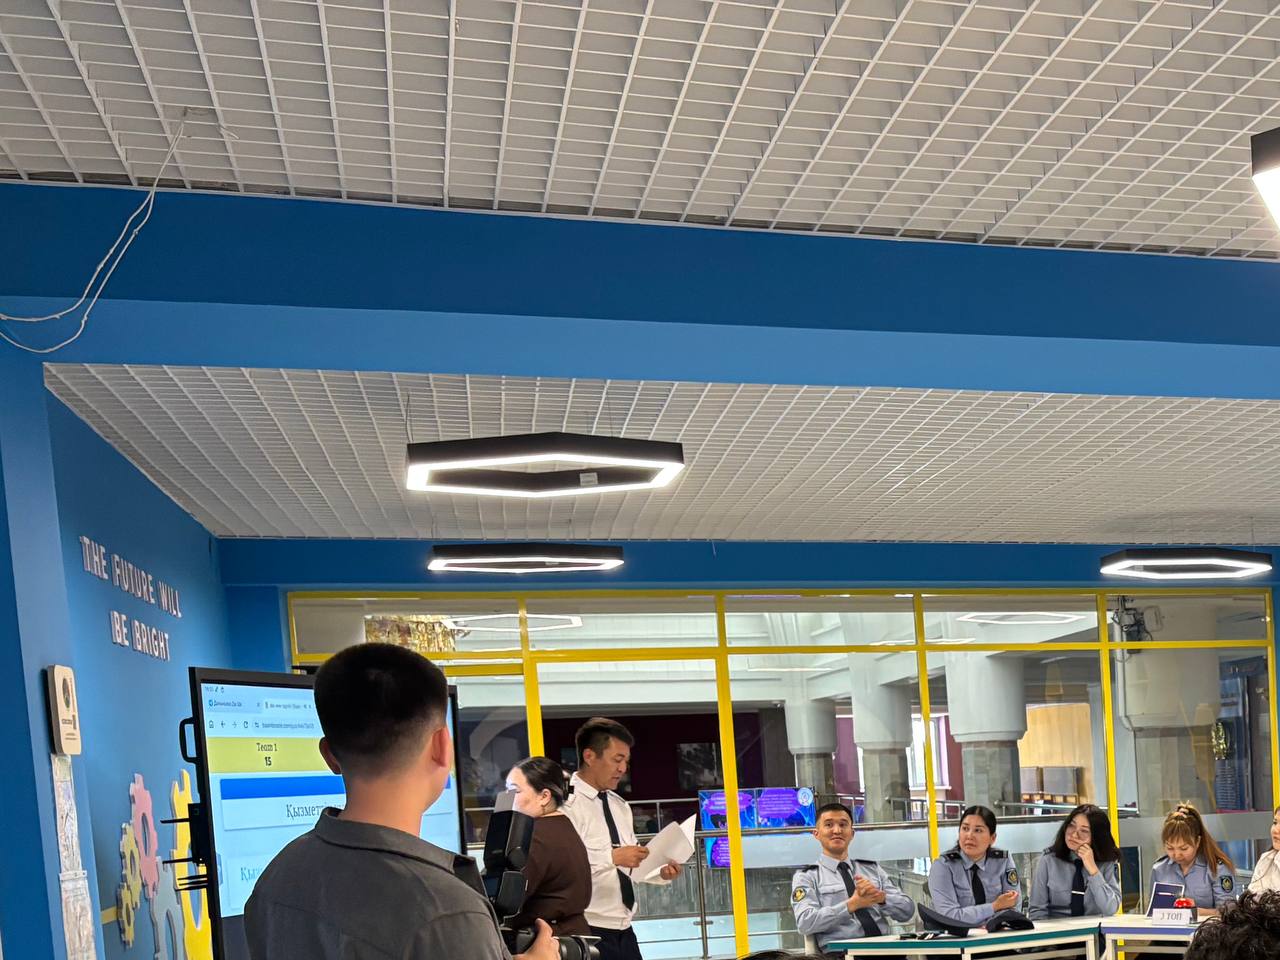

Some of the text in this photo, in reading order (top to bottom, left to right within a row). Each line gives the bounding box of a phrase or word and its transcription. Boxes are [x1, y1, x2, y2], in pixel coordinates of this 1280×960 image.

[79, 535, 182, 618] THE FUTURE WILL
[109, 610, 170, 661] BE BRIGHT
